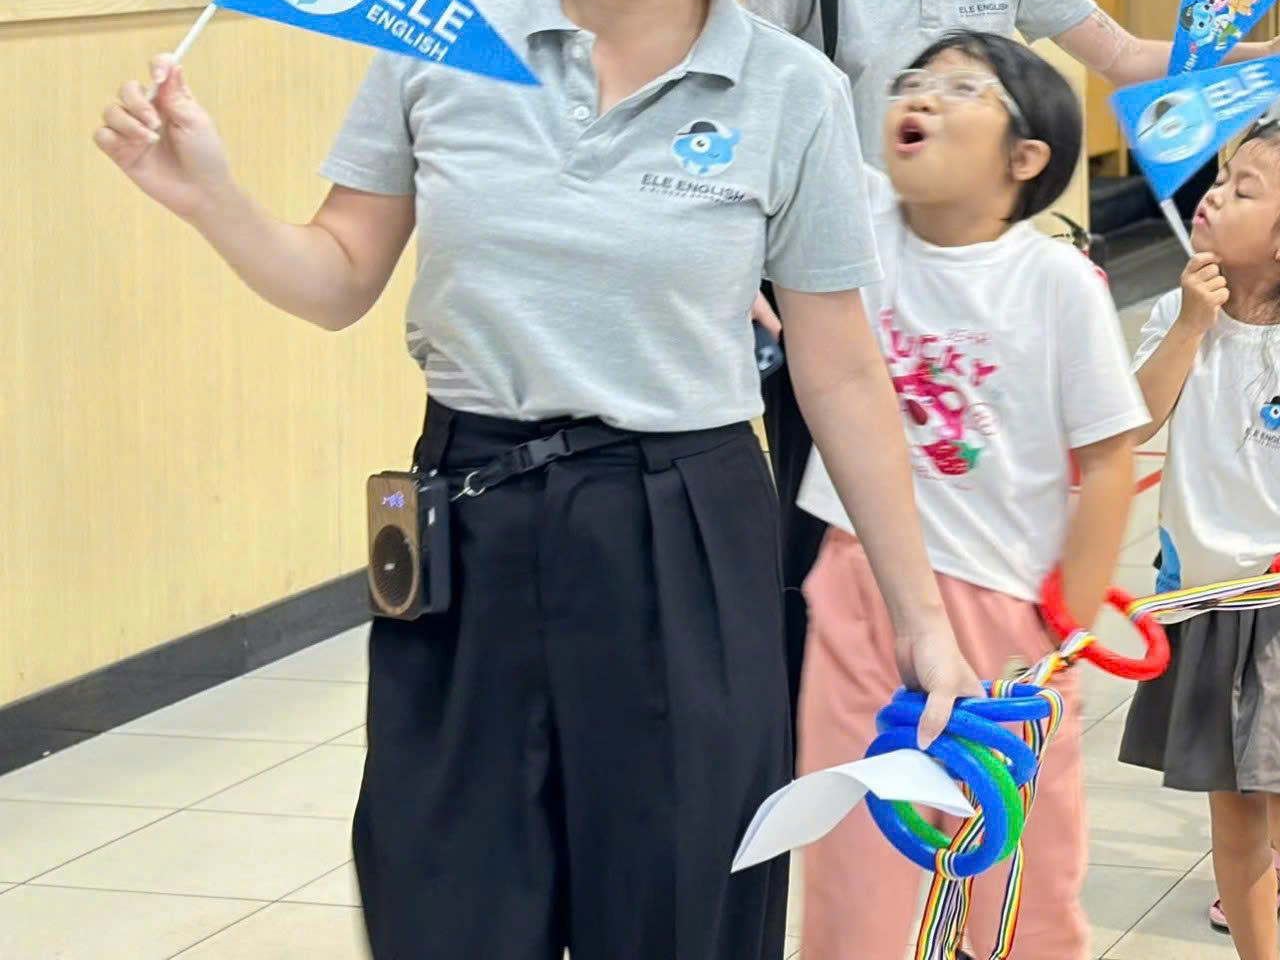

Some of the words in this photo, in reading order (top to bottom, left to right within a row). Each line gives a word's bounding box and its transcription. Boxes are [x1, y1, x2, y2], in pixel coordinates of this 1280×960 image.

[365, 5, 450, 62] ENGLISH
[640, 173, 673, 189] ELE
[676, 179, 745, 201] ENGLISH
